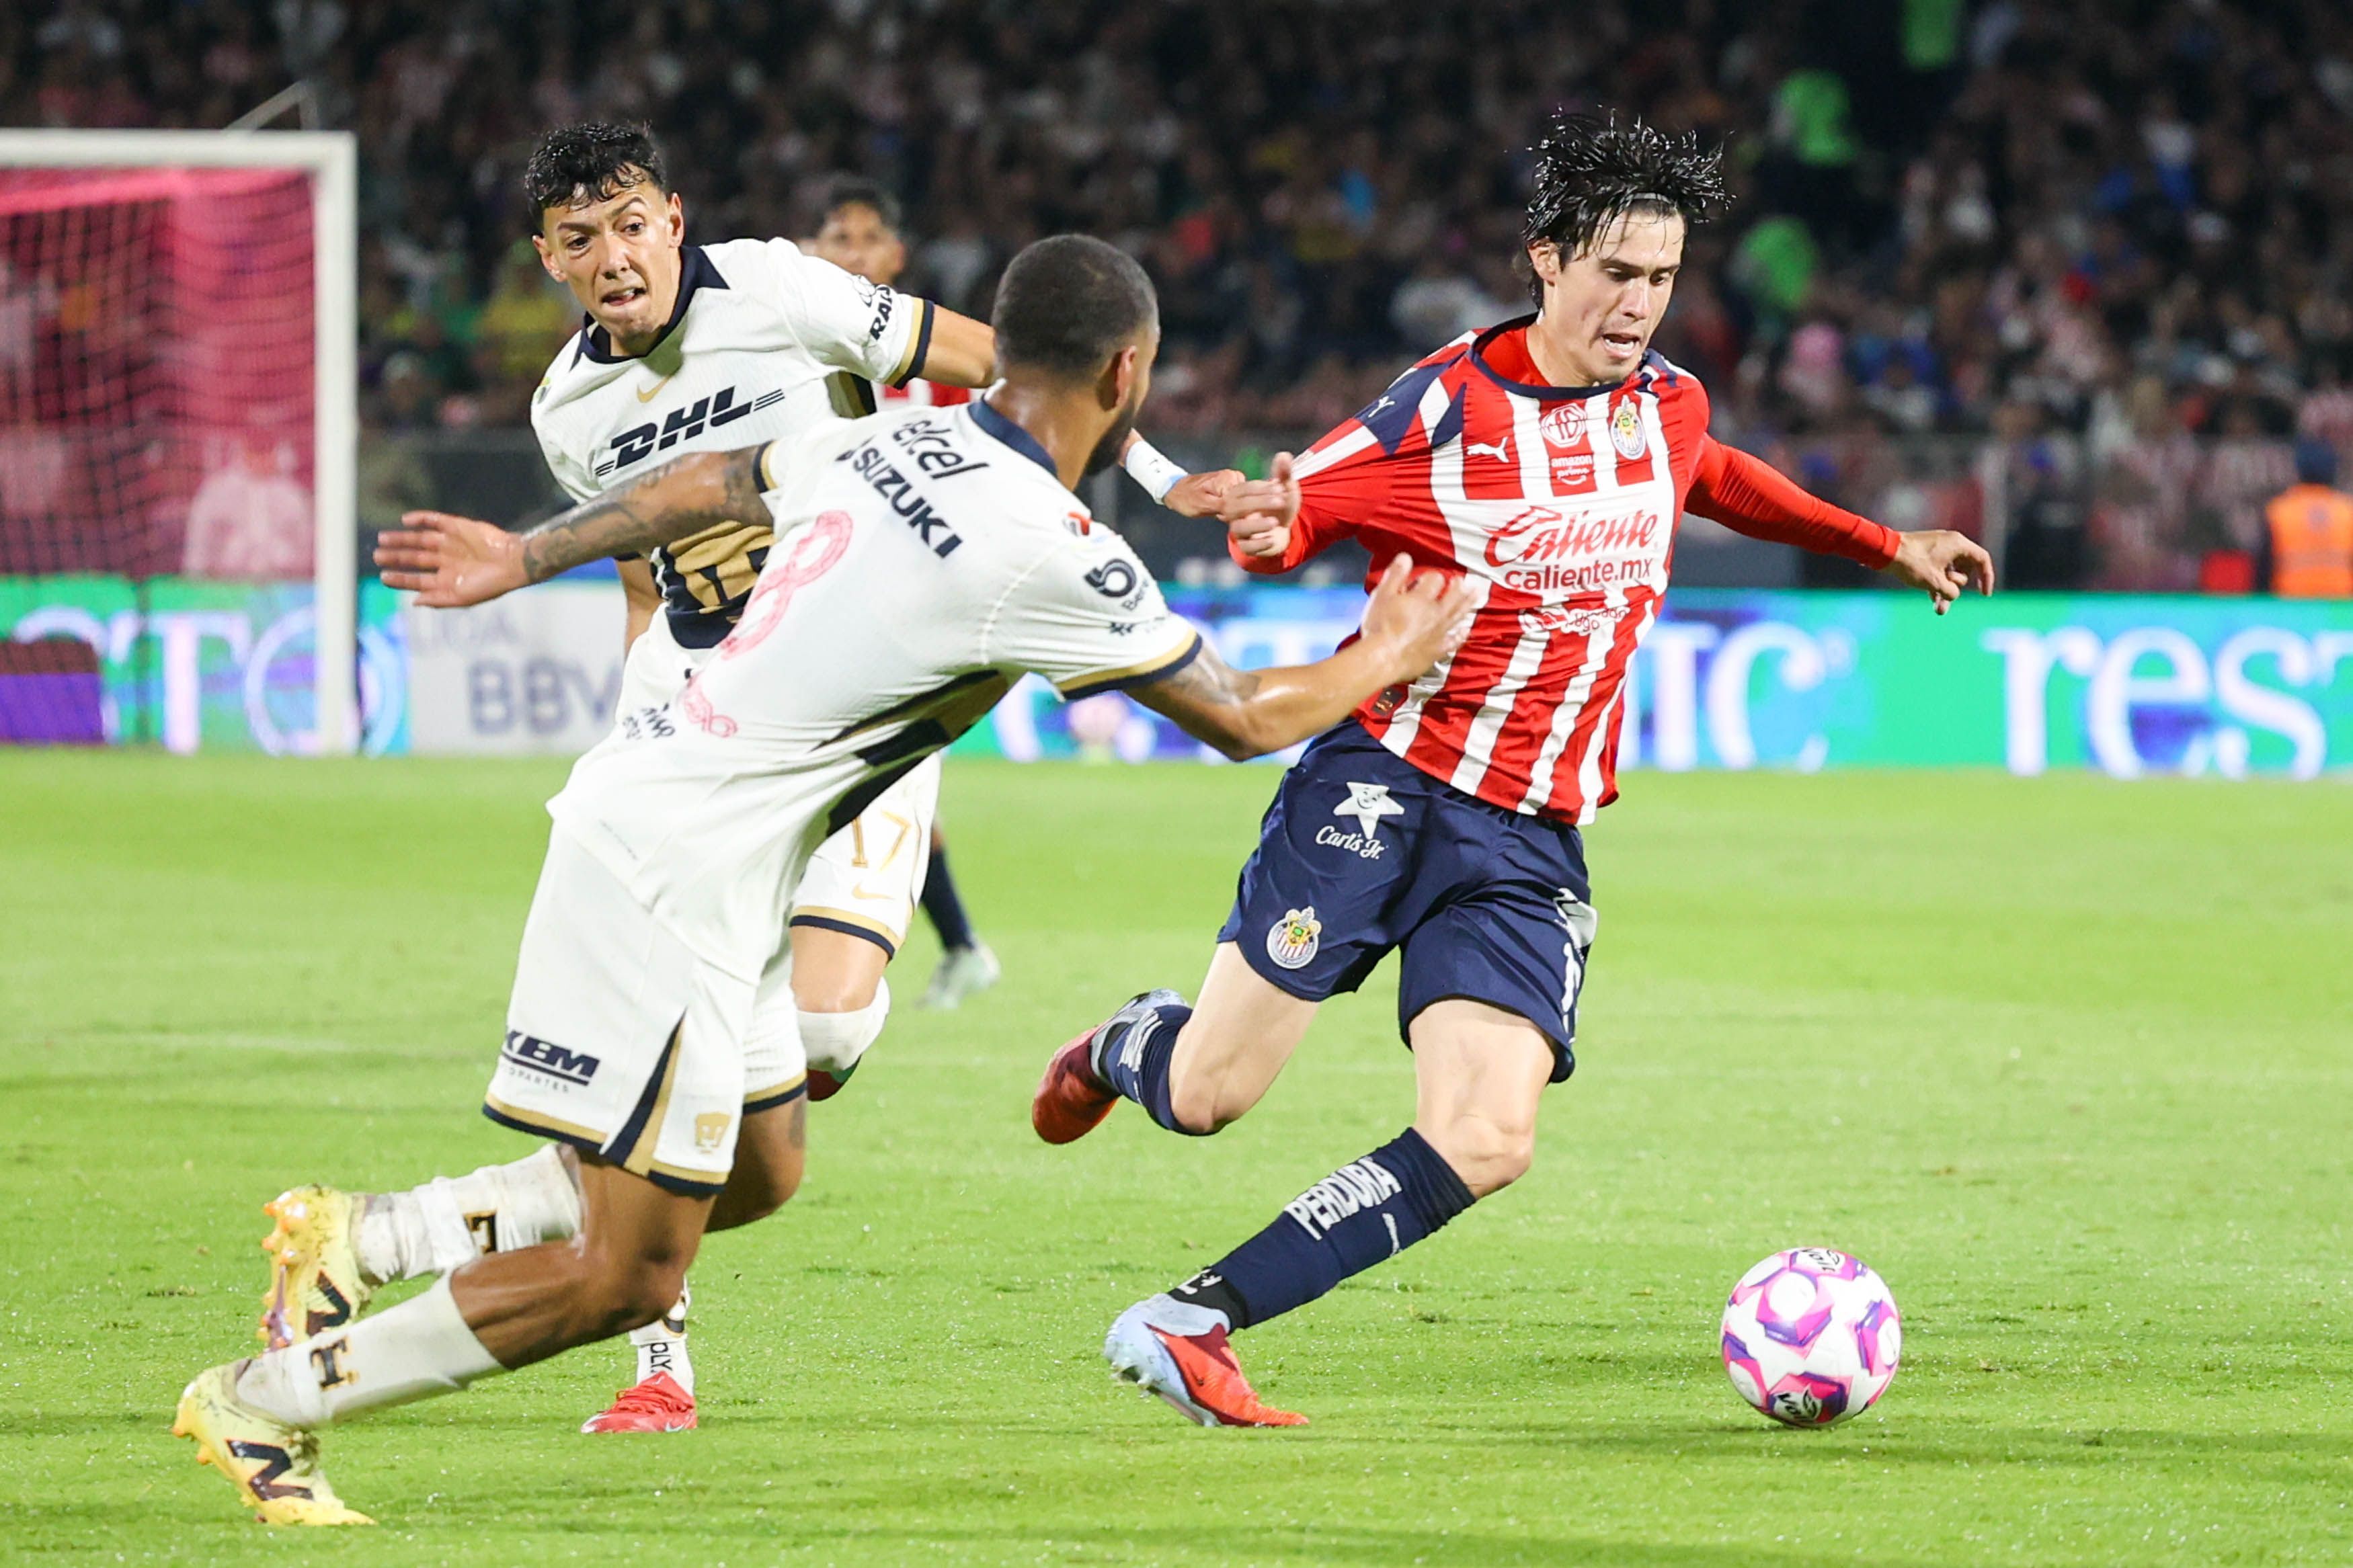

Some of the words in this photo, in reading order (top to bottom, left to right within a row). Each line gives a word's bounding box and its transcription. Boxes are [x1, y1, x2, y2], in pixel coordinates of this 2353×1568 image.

[610, 385, 753, 469] DHL
[1551, 454, 1593, 467] amazon
[853, 447, 963, 559] SUZUKI
[1481, 505, 1658, 567] Caliente
[1505, 558, 1653, 590] caliente.mx
[467, 655, 624, 736] BBV
[1979, 624, 2353, 781] res
[850, 811, 912, 872] 17
[1316, 825, 1363, 852] Carl's
[1359, 839, 1386, 860] Jr.
[1283, 1155, 1403, 1241] PERDURA
